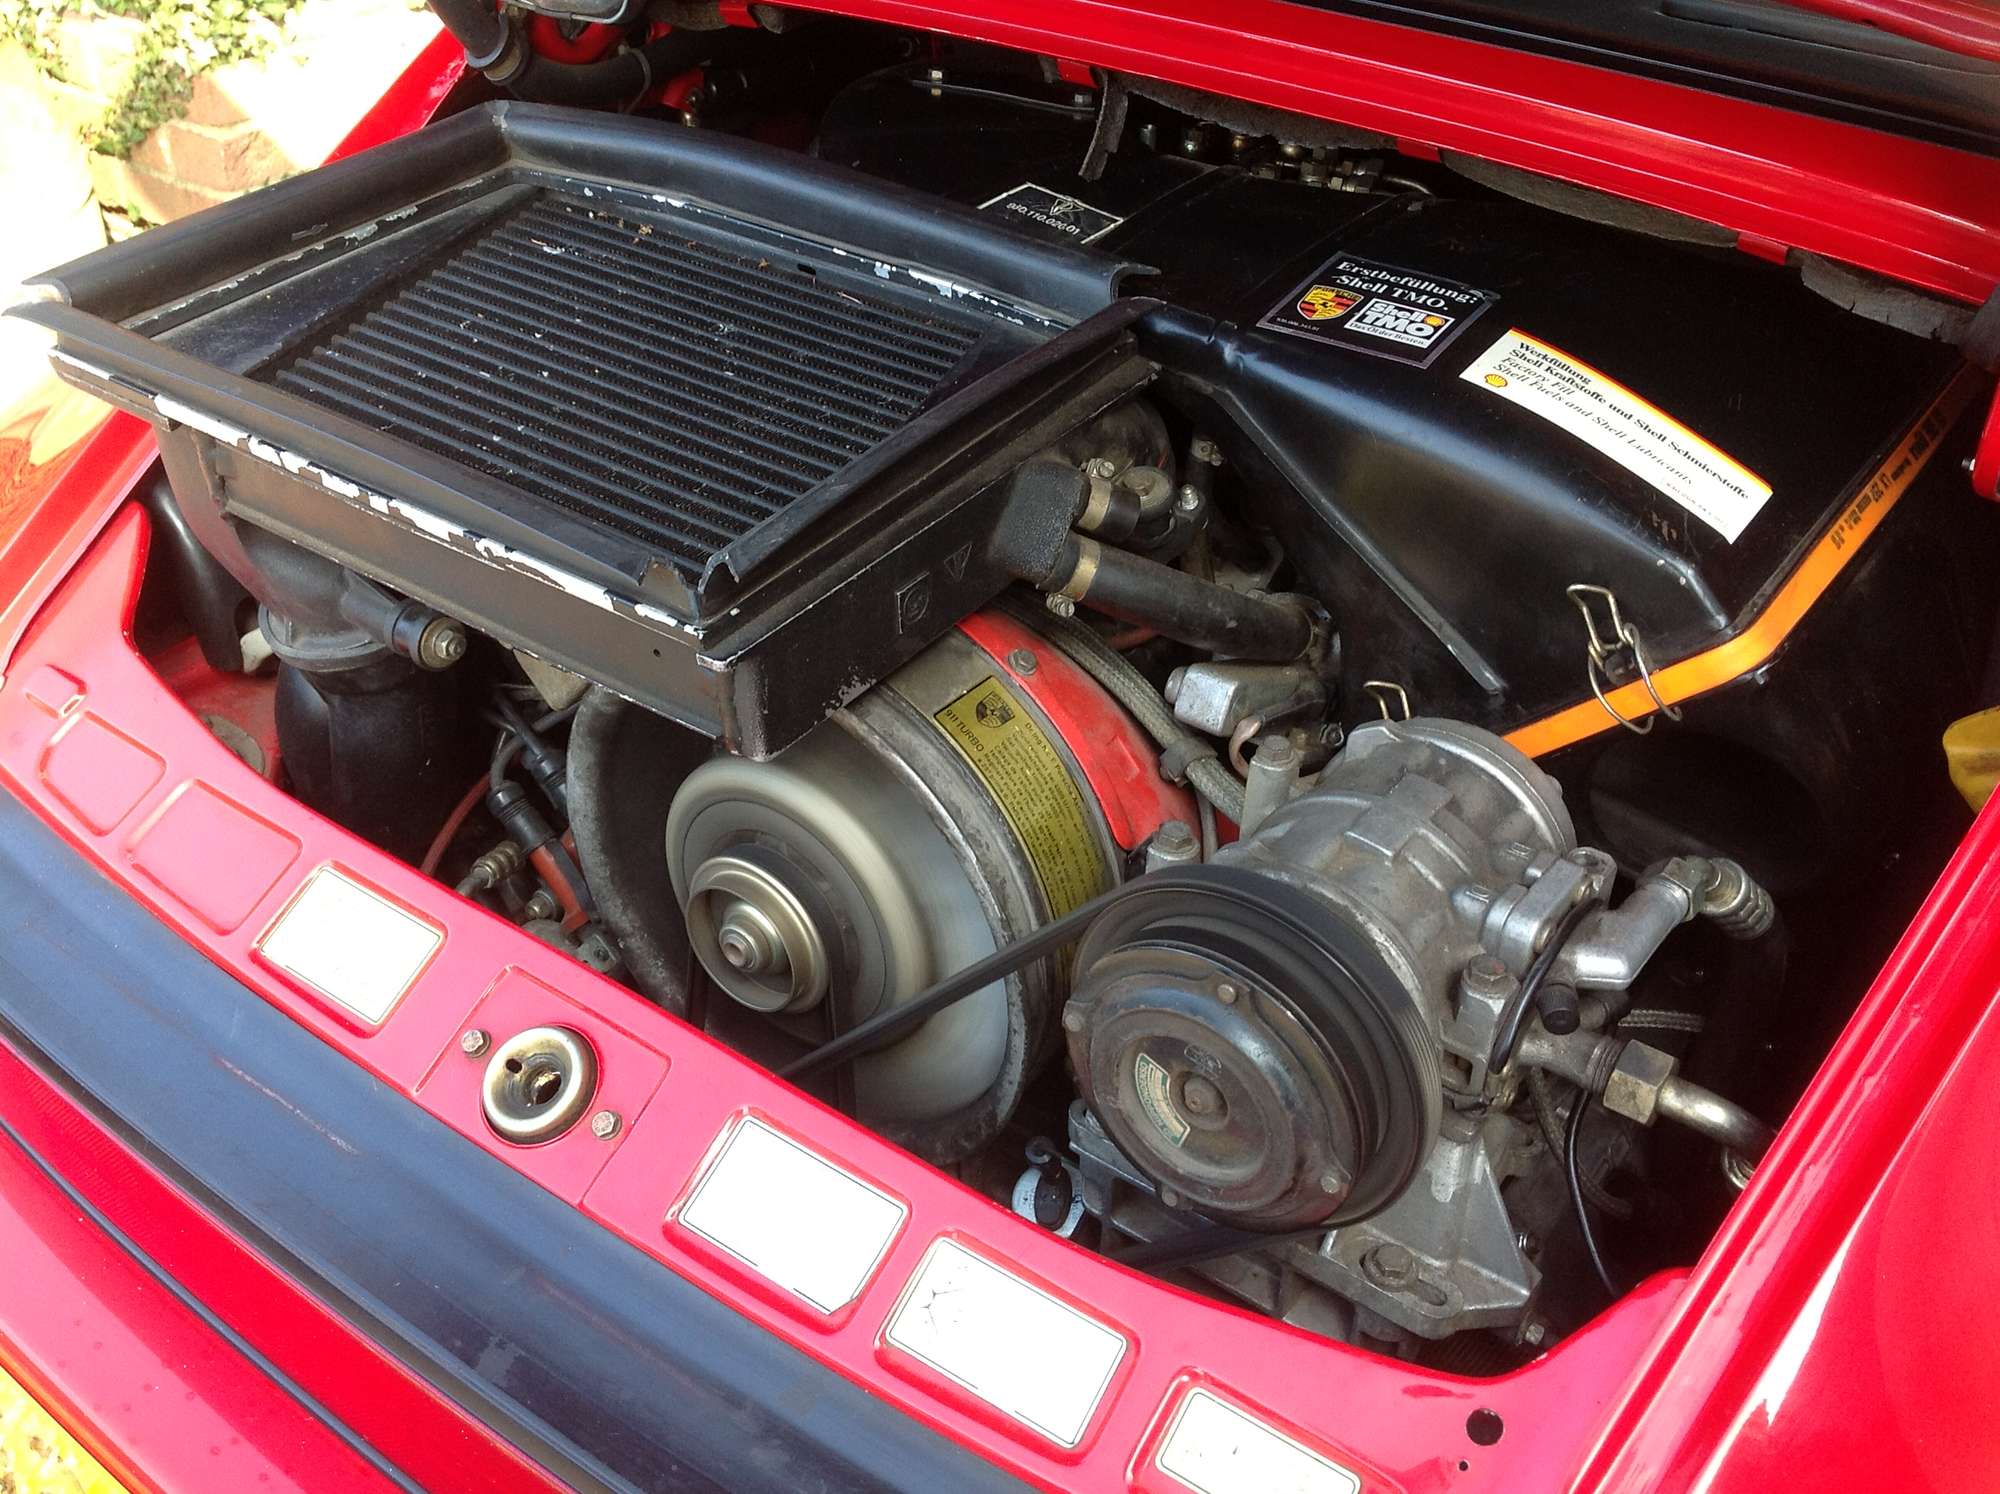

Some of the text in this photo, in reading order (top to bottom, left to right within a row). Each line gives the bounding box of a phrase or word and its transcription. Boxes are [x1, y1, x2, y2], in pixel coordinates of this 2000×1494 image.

[1336, 261, 1478, 304] Erstbefüllung:
[1336, 274, 1389, 294] Shell
[1361, 302, 1435, 337] Shell TMO
[1501, 357, 1576, 396] Factory Fill
[1519, 342, 1592, 385] Werkfüllung
[1492, 363, 1693, 485] Shell Fuels and Shell Lubricants
[1509, 349, 1749, 499] Shell Kraftstoffe und Shell Schmierstoffe
[944, 708, 985, 754] 911 TURBO
